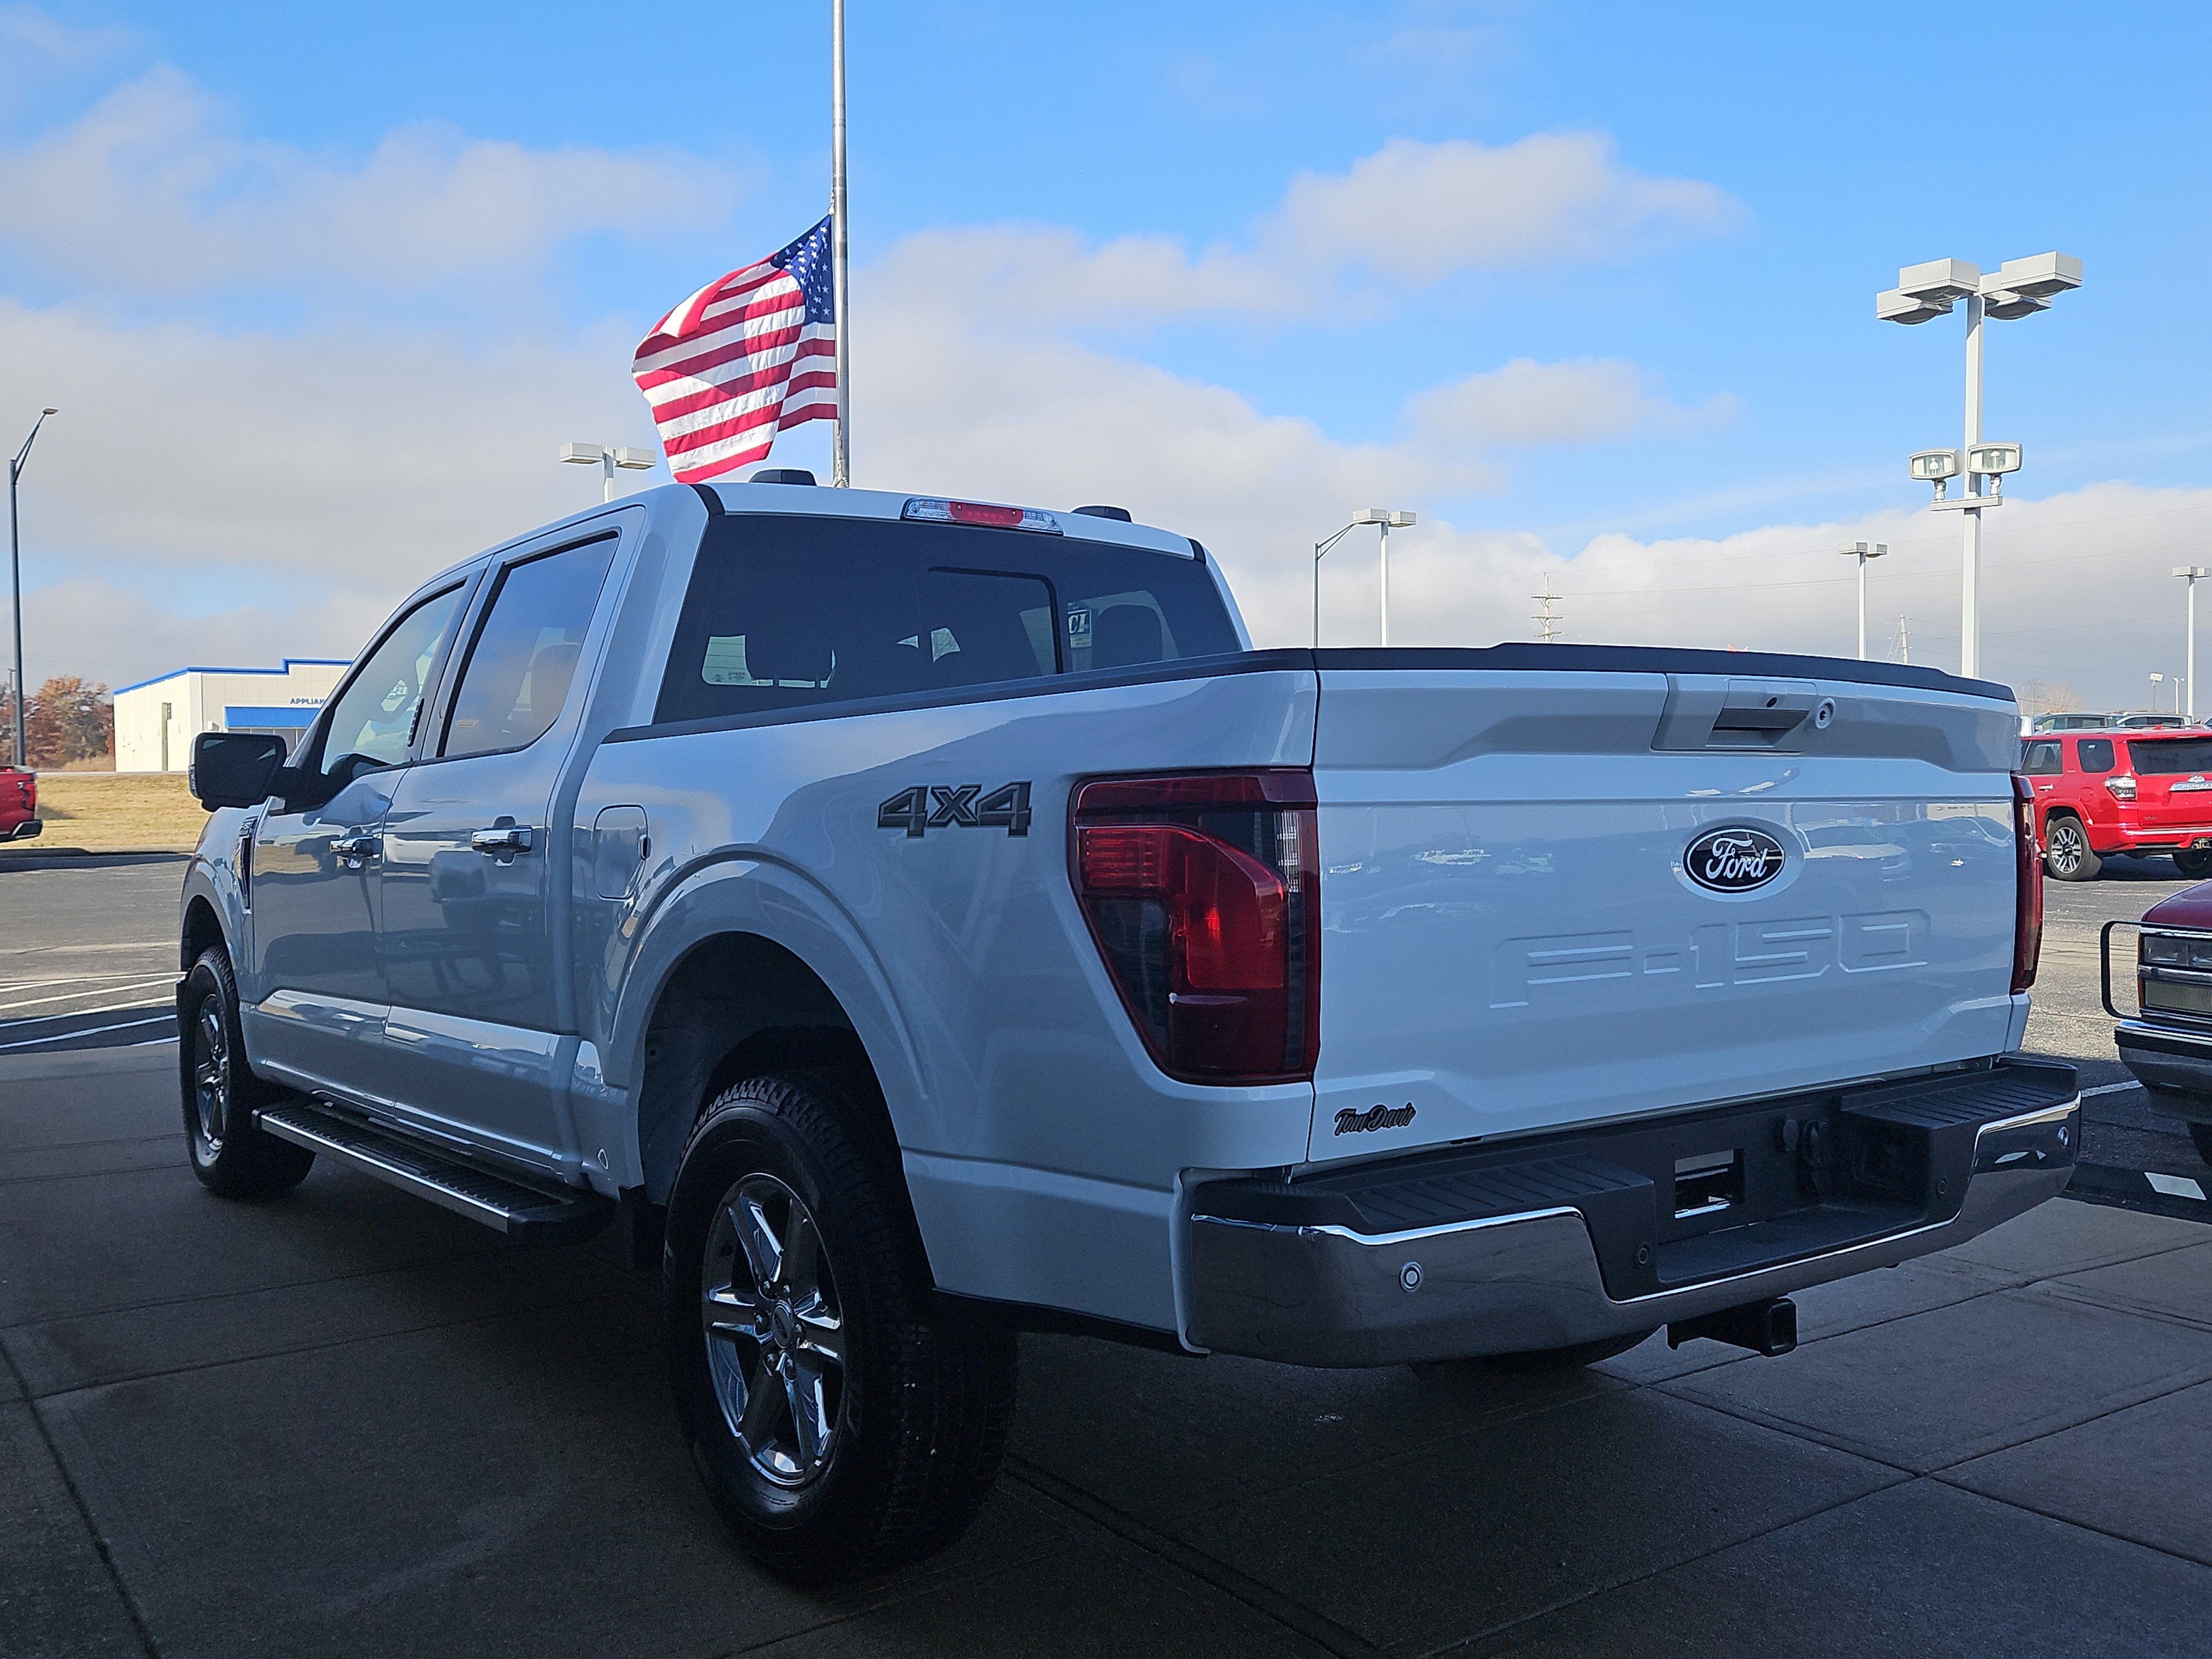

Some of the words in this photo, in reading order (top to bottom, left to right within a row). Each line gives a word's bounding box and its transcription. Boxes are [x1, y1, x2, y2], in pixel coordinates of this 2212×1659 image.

[1706, 837, 1769, 879] Ford
[1490, 907, 1932, 1008] F-150
[1334, 1108, 1369, 1136] Tom
[1366, 1102, 1417, 1132] Davis
